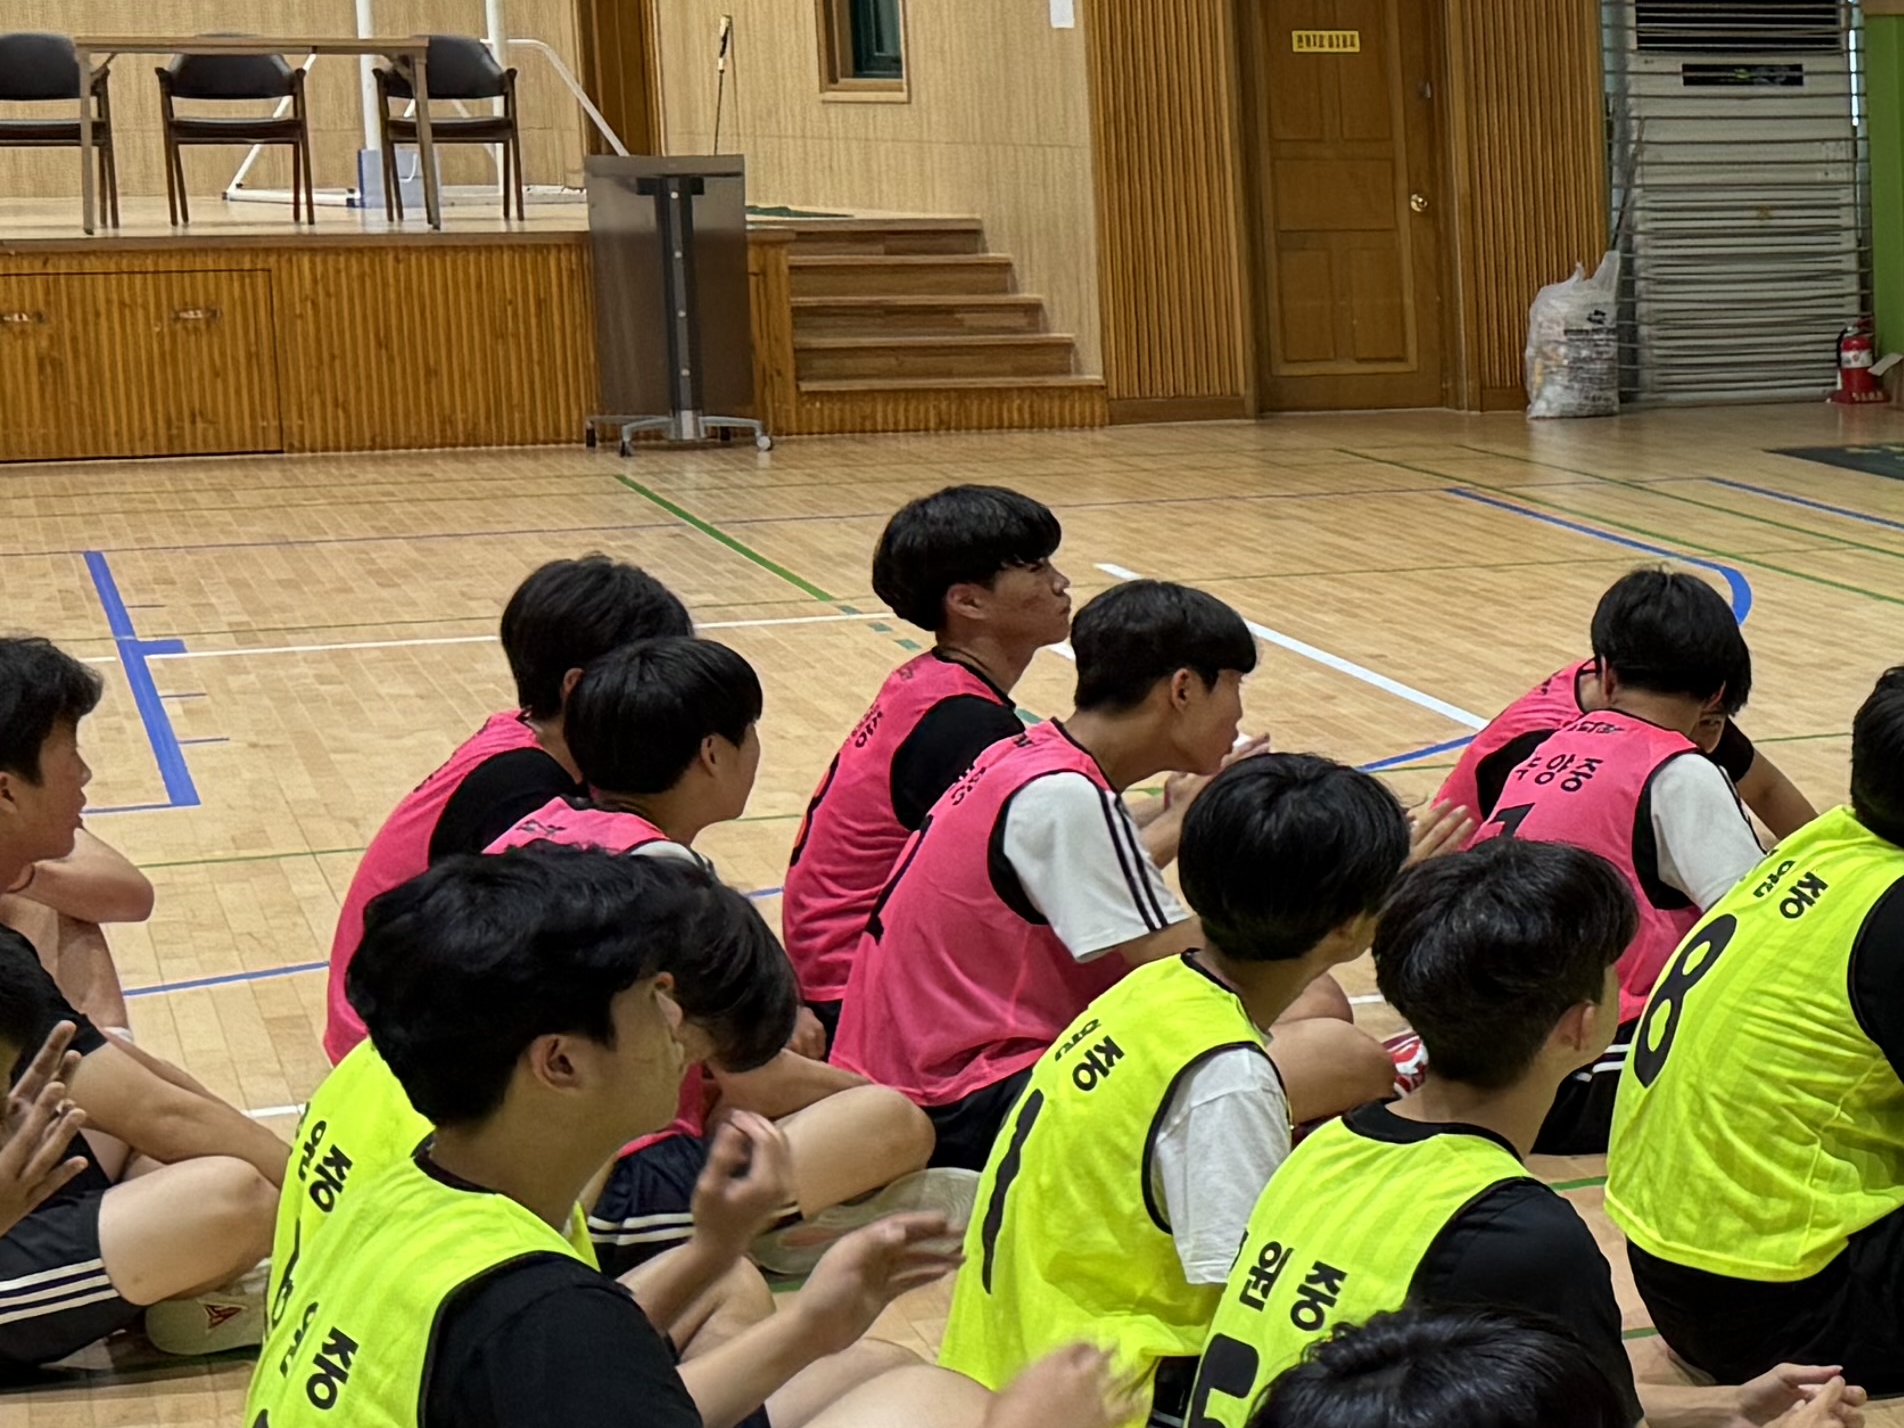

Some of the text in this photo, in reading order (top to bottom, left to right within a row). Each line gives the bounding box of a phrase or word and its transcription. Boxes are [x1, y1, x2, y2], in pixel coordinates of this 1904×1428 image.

[1740, 848, 1829, 920] 원중
[1633, 912, 1738, 1090] 8
[1223, 1228, 1349, 1333] 원중
